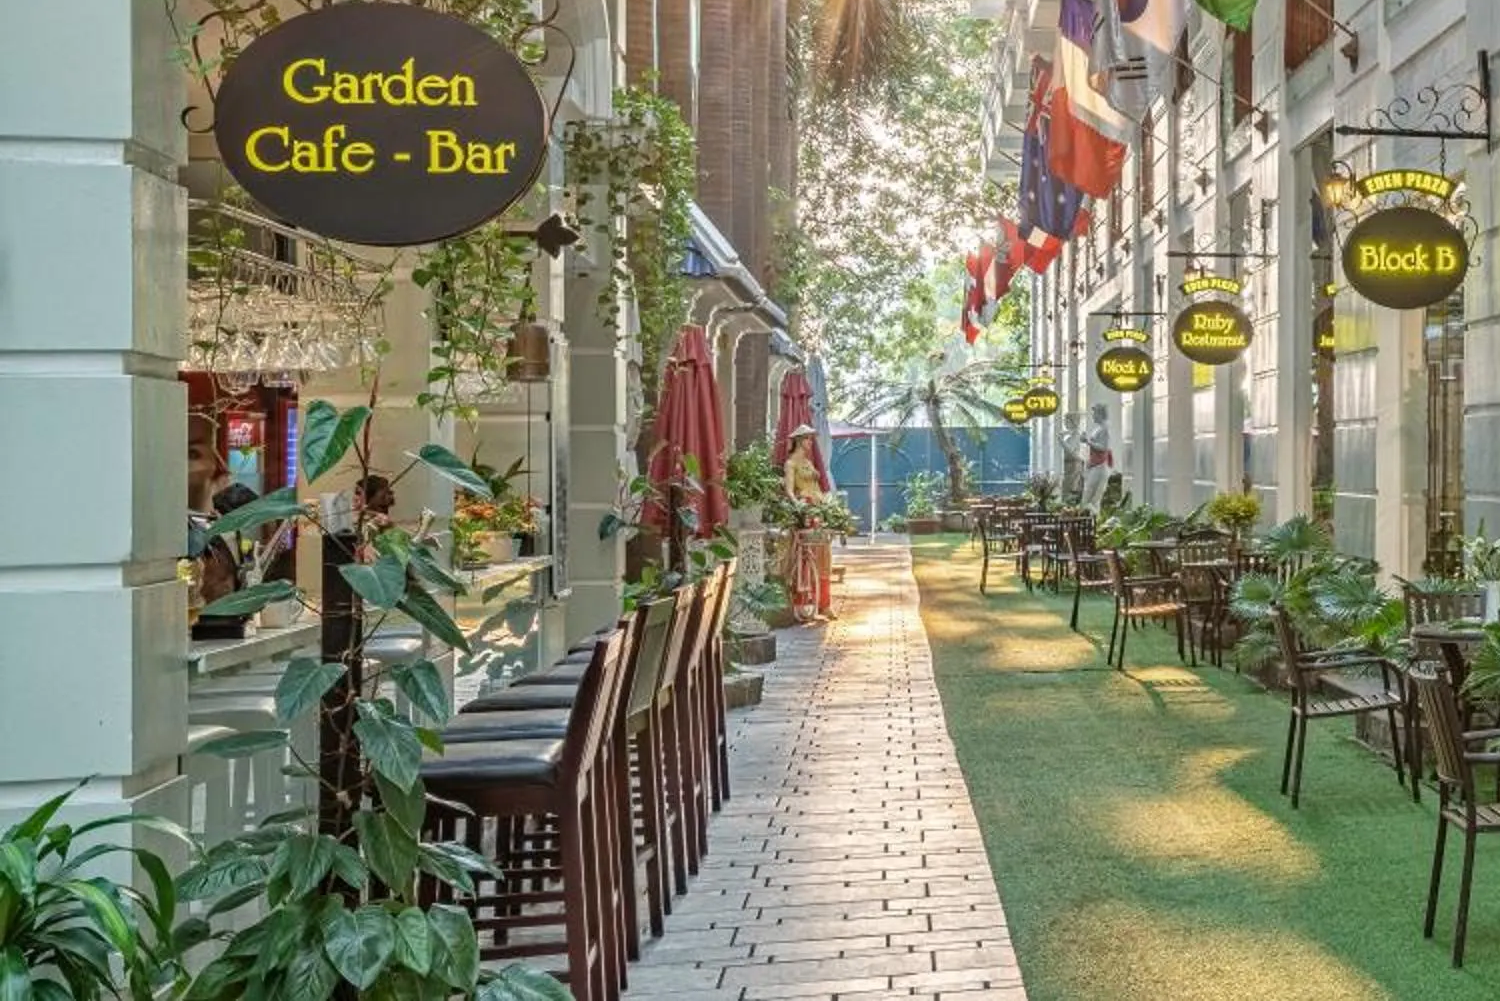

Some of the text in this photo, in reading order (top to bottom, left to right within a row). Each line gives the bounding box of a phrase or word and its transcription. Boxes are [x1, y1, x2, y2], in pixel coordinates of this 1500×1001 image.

[282, 58, 477, 106] Garden
[245, 124, 376, 174] Cafe
[426, 130, 516, 175] Bar
[1365, 172, 1451, 198] EDEN PLAZA
[1360, 243, 1458, 272] Block B
[1193, 313, 1235, 334] Ruby
[1138, 360, 1150, 374] A
